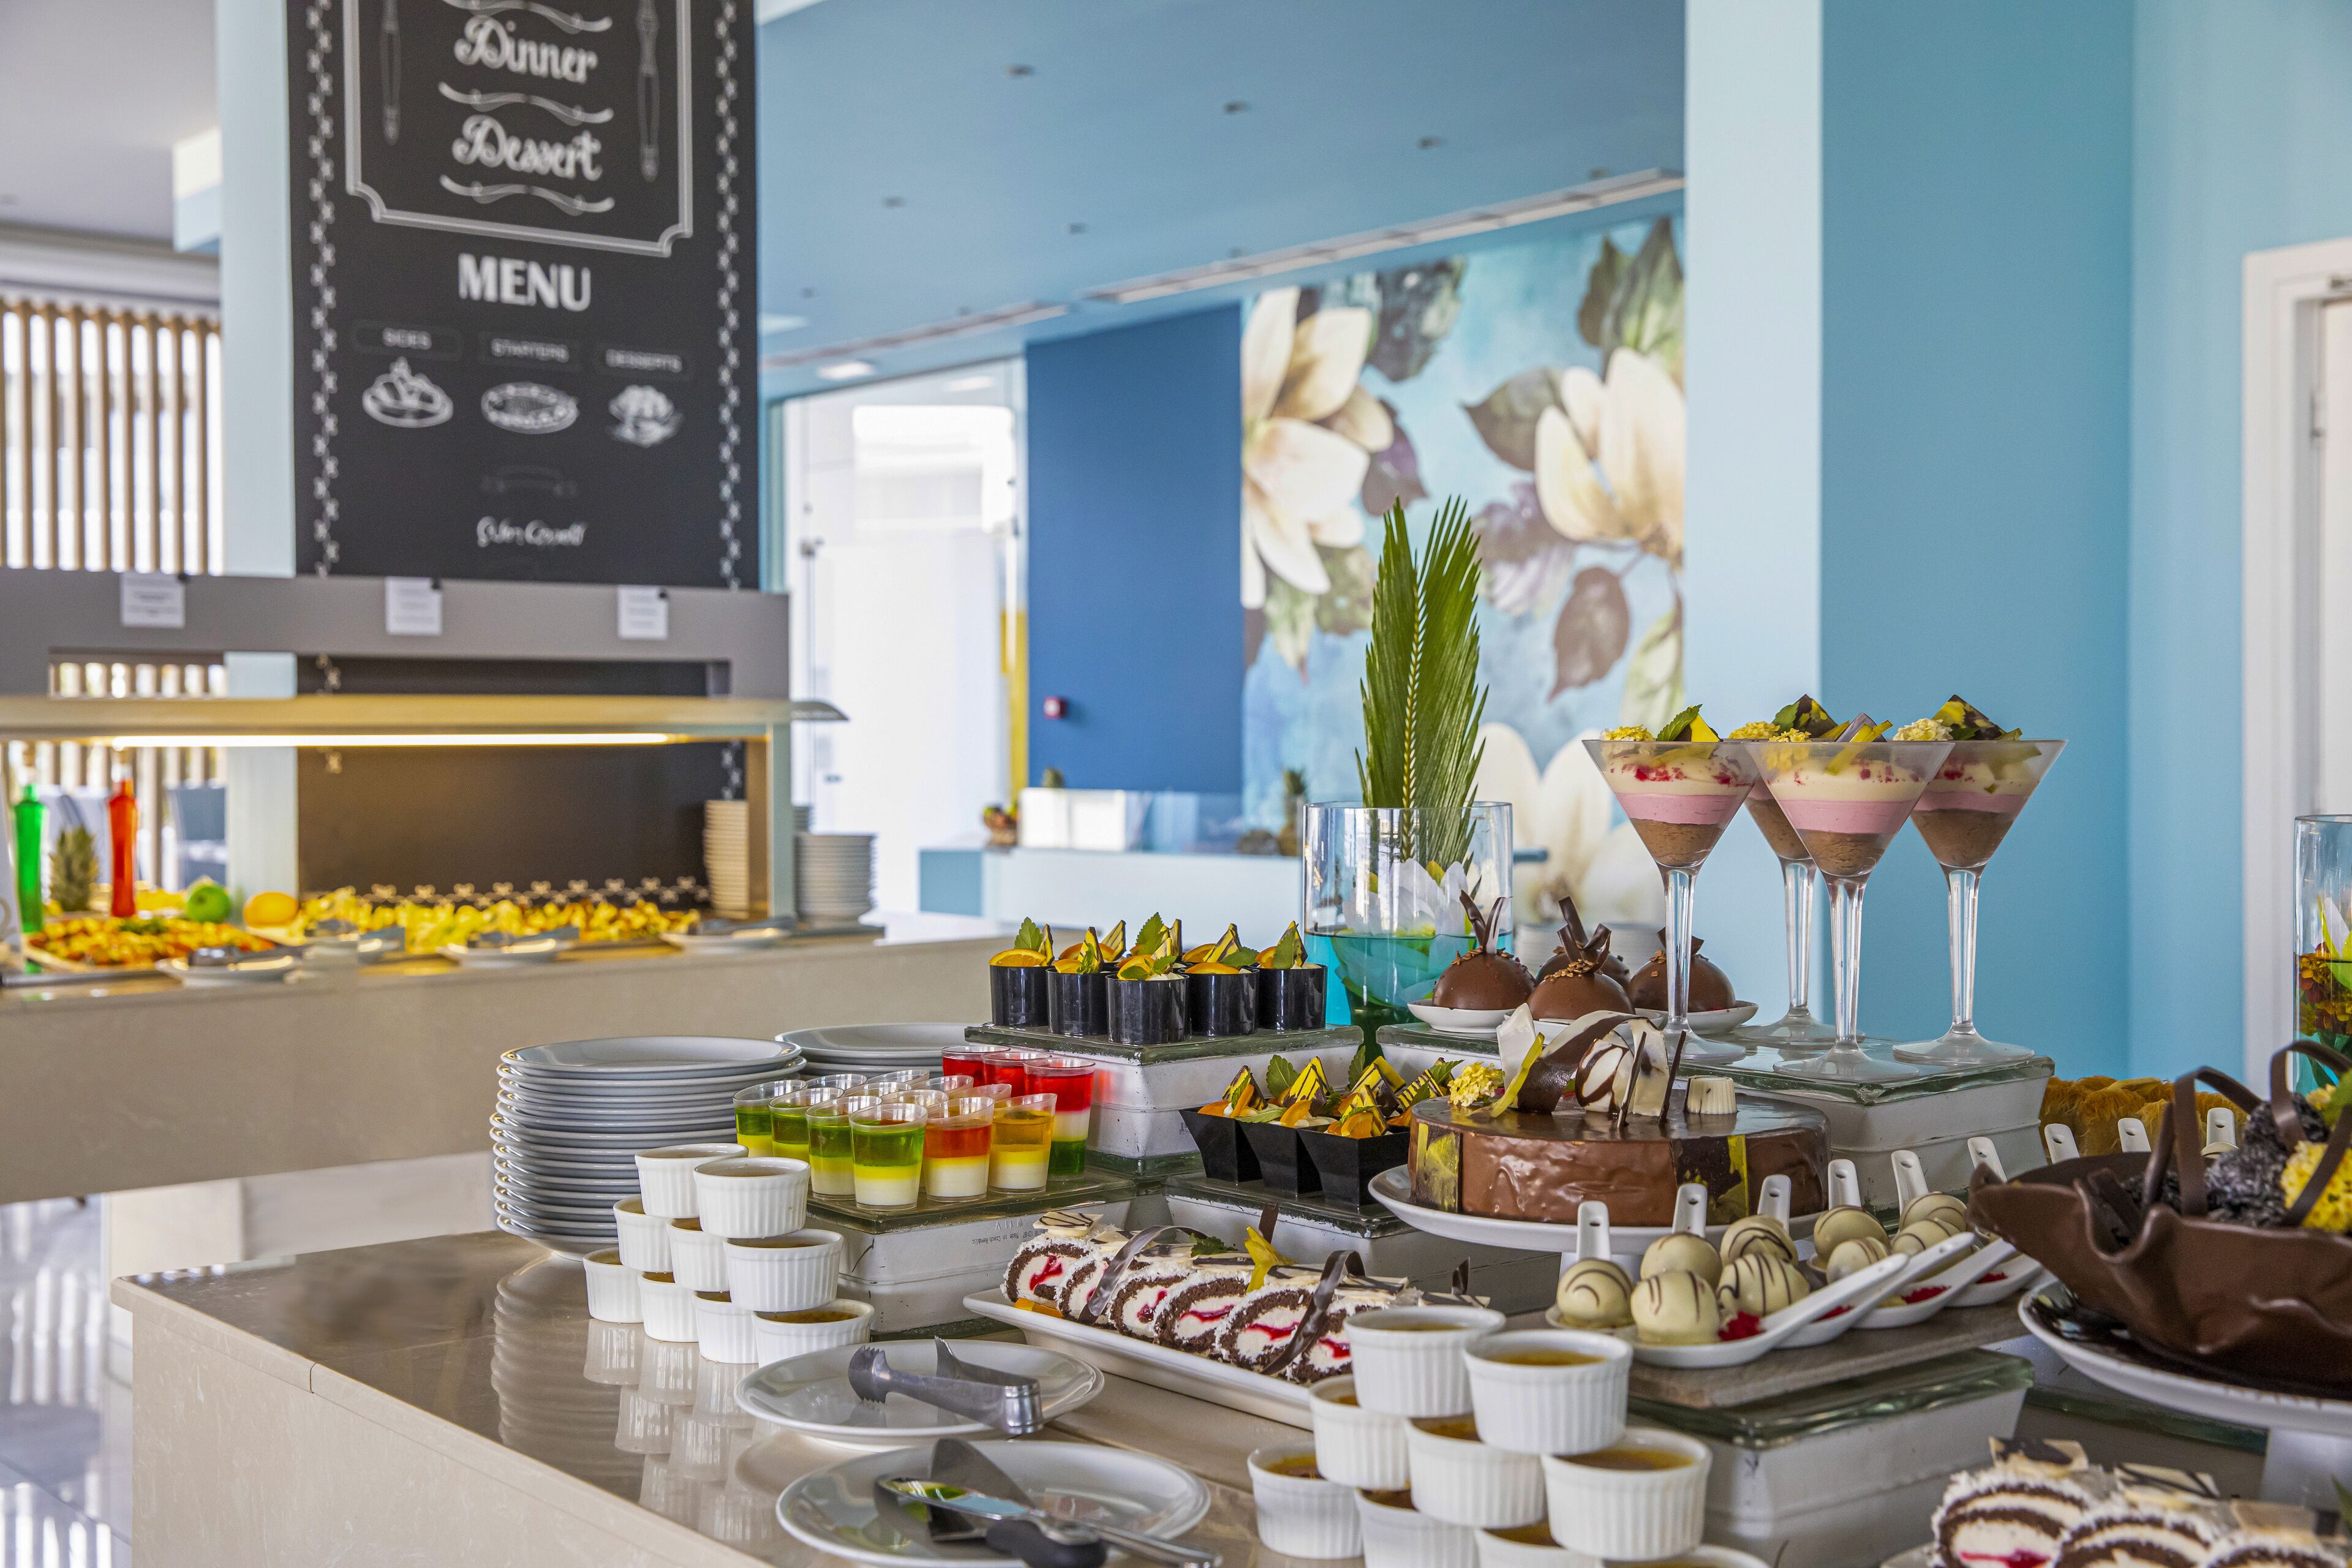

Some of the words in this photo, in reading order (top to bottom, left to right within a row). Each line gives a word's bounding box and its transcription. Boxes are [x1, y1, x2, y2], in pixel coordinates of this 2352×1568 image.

[454, 15, 598, 84] Dinner
[451, 114, 603, 181] Dessert
[459, 252, 591, 312] MENU
